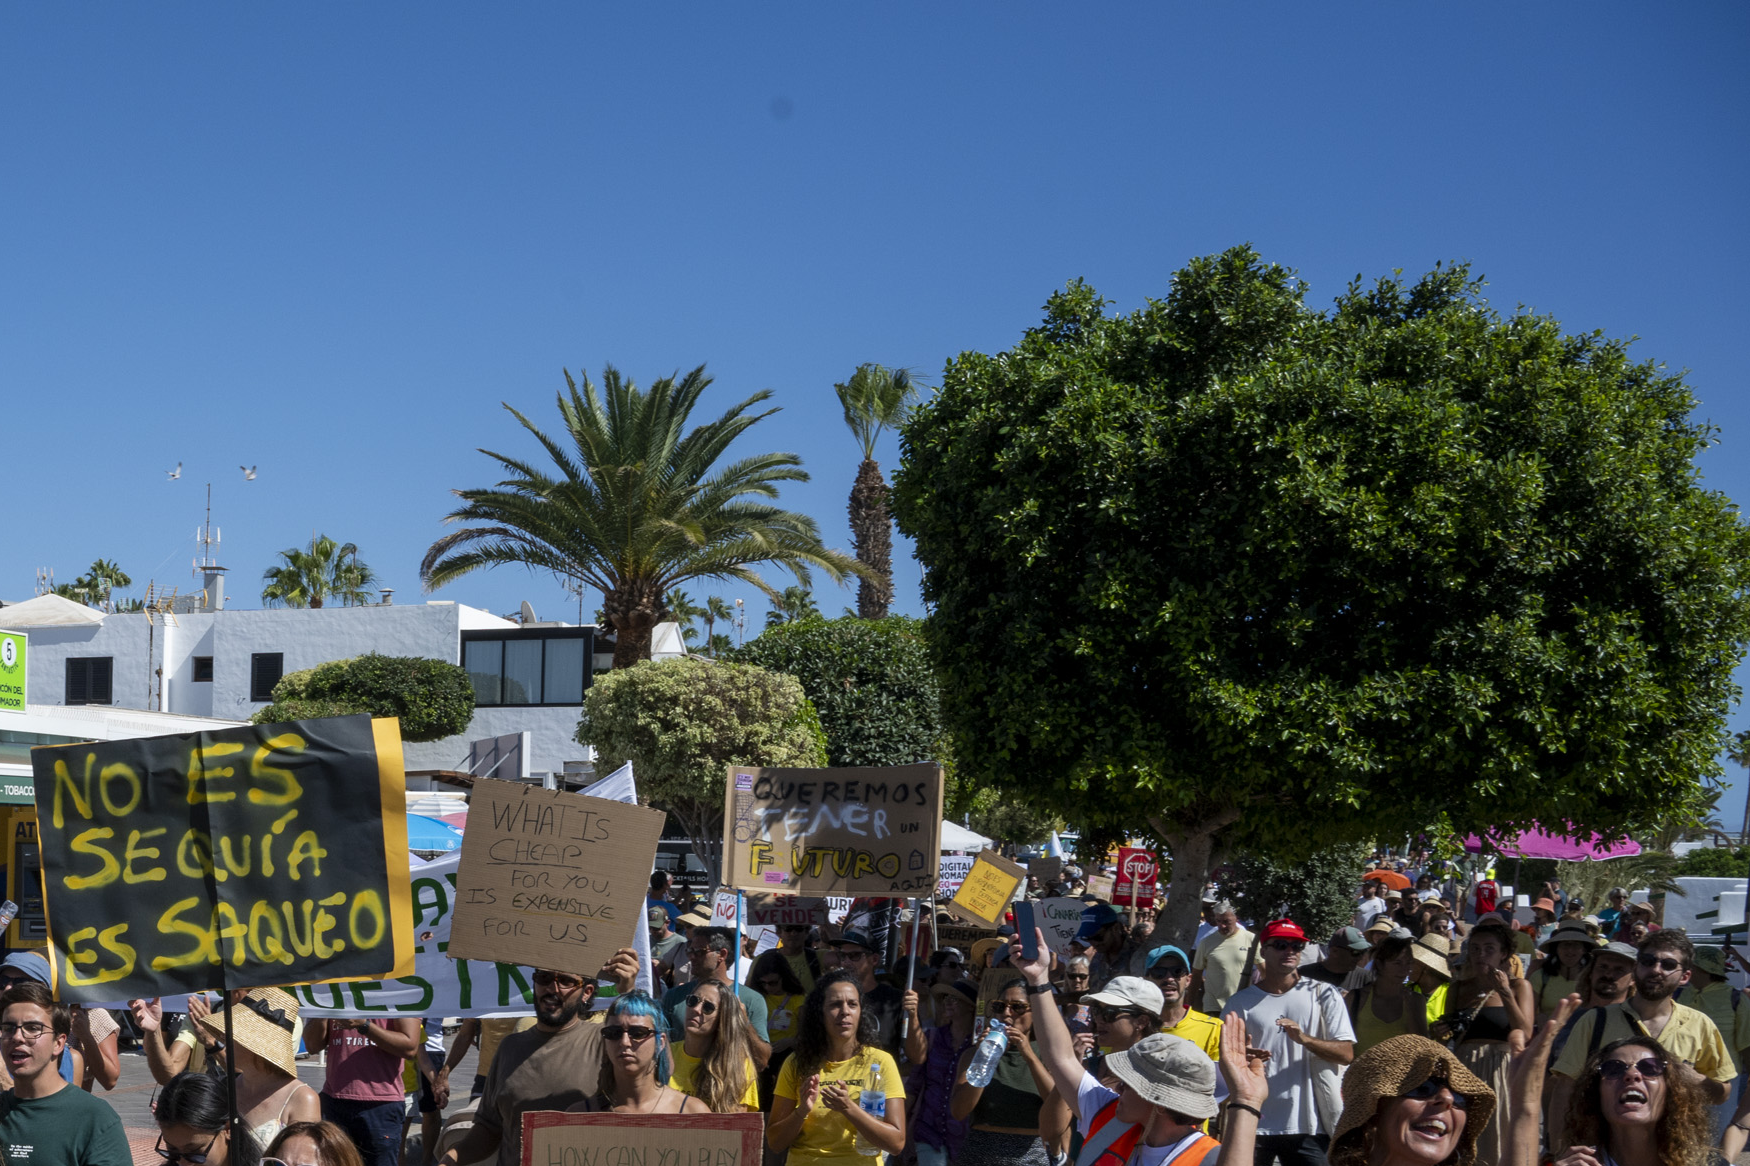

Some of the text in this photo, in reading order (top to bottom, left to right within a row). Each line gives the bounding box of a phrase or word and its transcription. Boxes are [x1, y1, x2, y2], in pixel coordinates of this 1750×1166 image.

[7, 642, 11, 660] 5
[13, 685, 23, 695] DEL
[53, 733, 306, 829] NO ES
[754, 776, 926, 806] QUEREMOS
[493, 800, 610, 842] WHAT IS
[754, 803, 919, 842] TENER UN
[63, 809, 327, 890] SEQUÍA
[489, 838, 582, 864] CHEAP
[512, 870, 611, 897] FOR YOU,
[465, 888, 615, 920] IS EXPENSIVE
[717, 903, 735, 920] NO
[776, 896, 797, 908] SE
[483, 918, 588, 942] FOR US
[755, 909, 818, 924] VENDE
[65, 923, 137, 987] ES
[152, 889, 385, 971] SAQUEO
